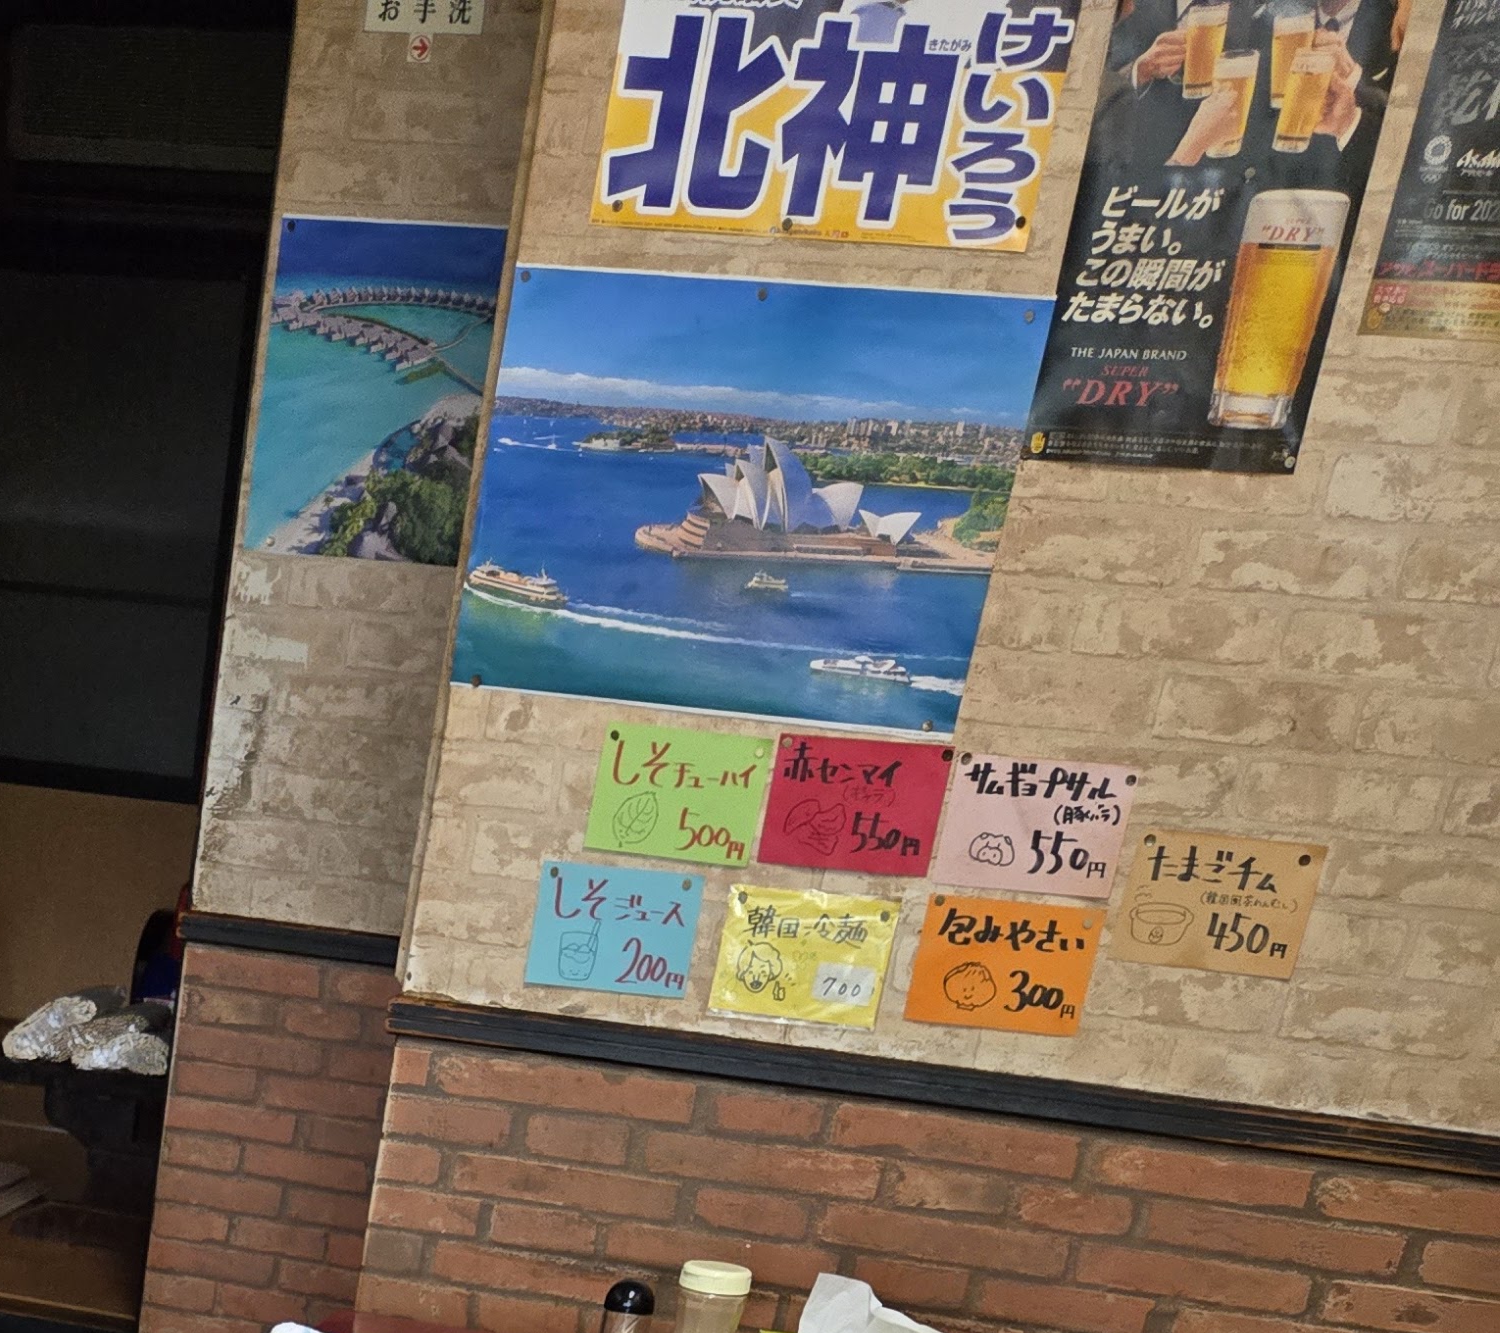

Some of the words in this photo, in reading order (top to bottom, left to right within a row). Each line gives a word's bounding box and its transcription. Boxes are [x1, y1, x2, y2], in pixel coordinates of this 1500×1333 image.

[607, 14, 960, 222] 北神
[949, 12, 1070, 241] けいろう
[1101, 185, 1226, 221] ビールが
[1446, 199, 1470, 220] for
[1091, 220, 1182, 255] うまい。
[1075, 258, 1226, 292] この瞬間が
[1061, 291, 1213, 329] たまらない。
[1071, 346, 1094, 359] THE
[1098, 347, 1138, 360] JAPAN
[1142, 349, 1188, 361] BRAND
[1102, 364, 1150, 377] SUPER
[612, 741, 758, 789] しそチューハイ
[783, 742, 902, 788] 赤センマイ
[965, 762, 1117, 801] サムギョプサル
[675, 807, 746, 860] 500円
[850, 811, 921, 856] 550円
[1027, 830, 1107, 879] 550円
[1148, 845, 1277, 894] たまごチム
[554, 876, 685, 928] しそジュース
[938, 908, 1085, 952] 包みやさい
[1207, 912, 1288, 959] 450円
[615, 937, 684, 989] 200円
[822, 976, 862, 997] 700
[1004, 970, 1076, 1019] 300円
